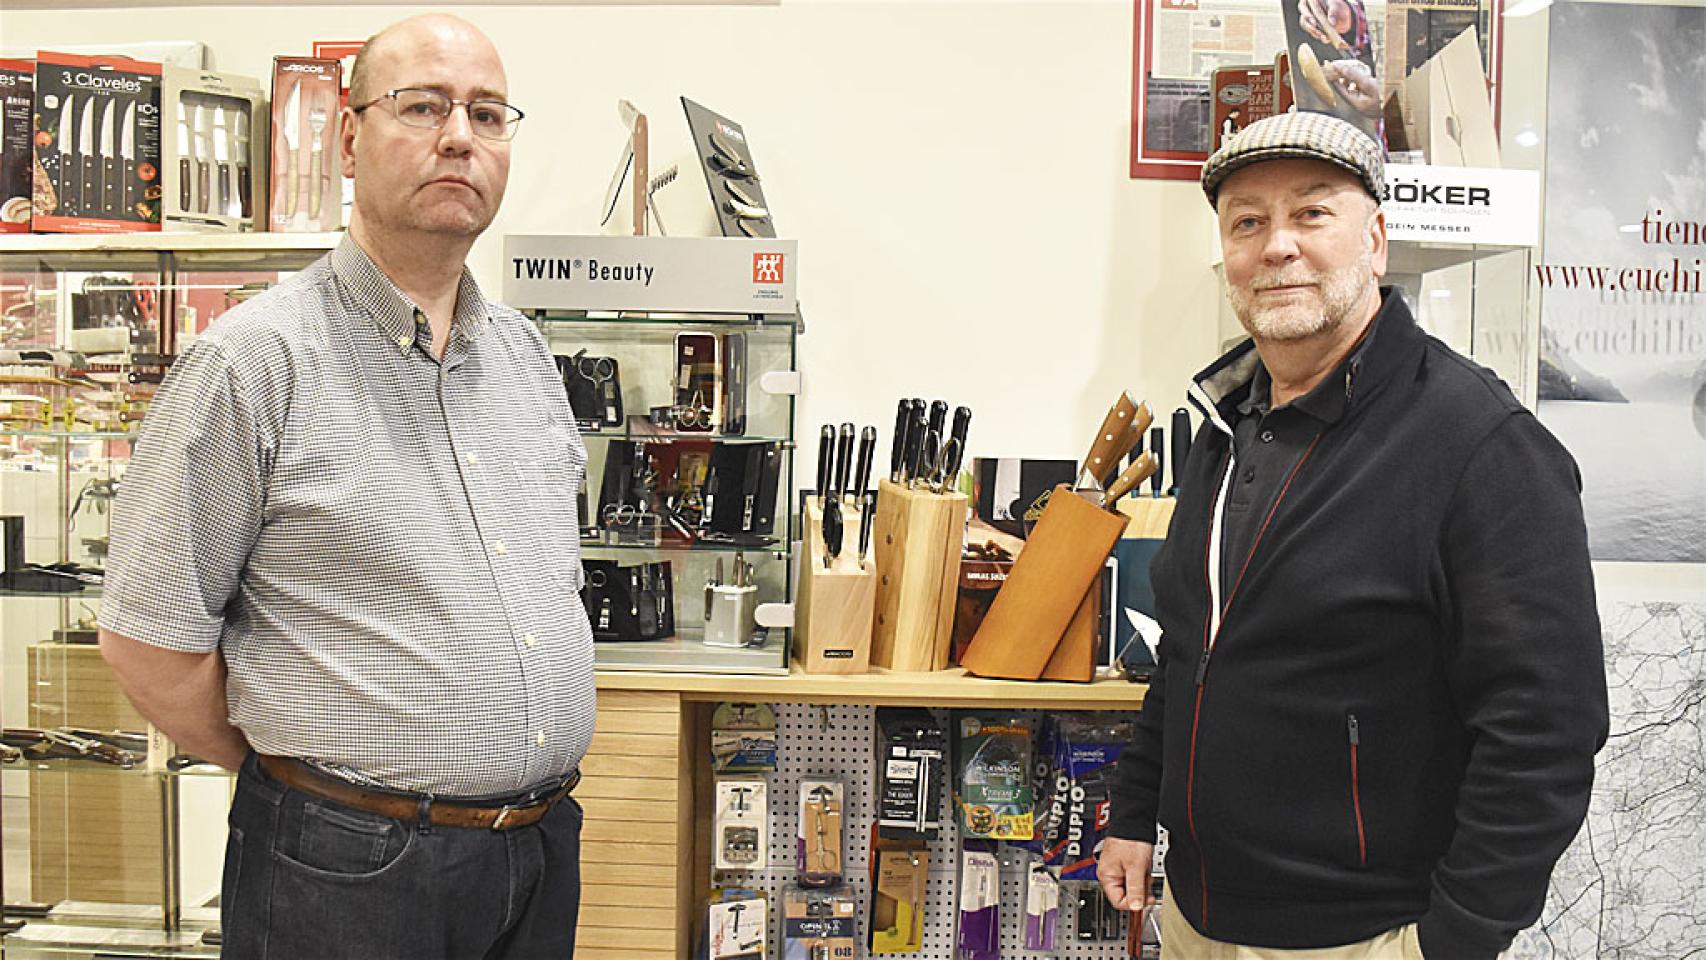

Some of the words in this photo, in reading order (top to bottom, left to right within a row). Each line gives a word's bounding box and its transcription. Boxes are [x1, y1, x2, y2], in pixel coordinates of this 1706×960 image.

[62, 71, 72, 85] 3
[75, 72, 142, 93] Claveles
[1383, 205, 1437, 213] NUFAKTUR
[1420, 224, 1471, 233] MESSER
[588, 259, 654, 286] Beauty
[1535, 258, 1702, 293] www.cuchi
[1046, 776, 1069, 839] DUPLO
[1098, 802, 1111, 826] 5
[1067, 786, 1085, 856] DUPLO
